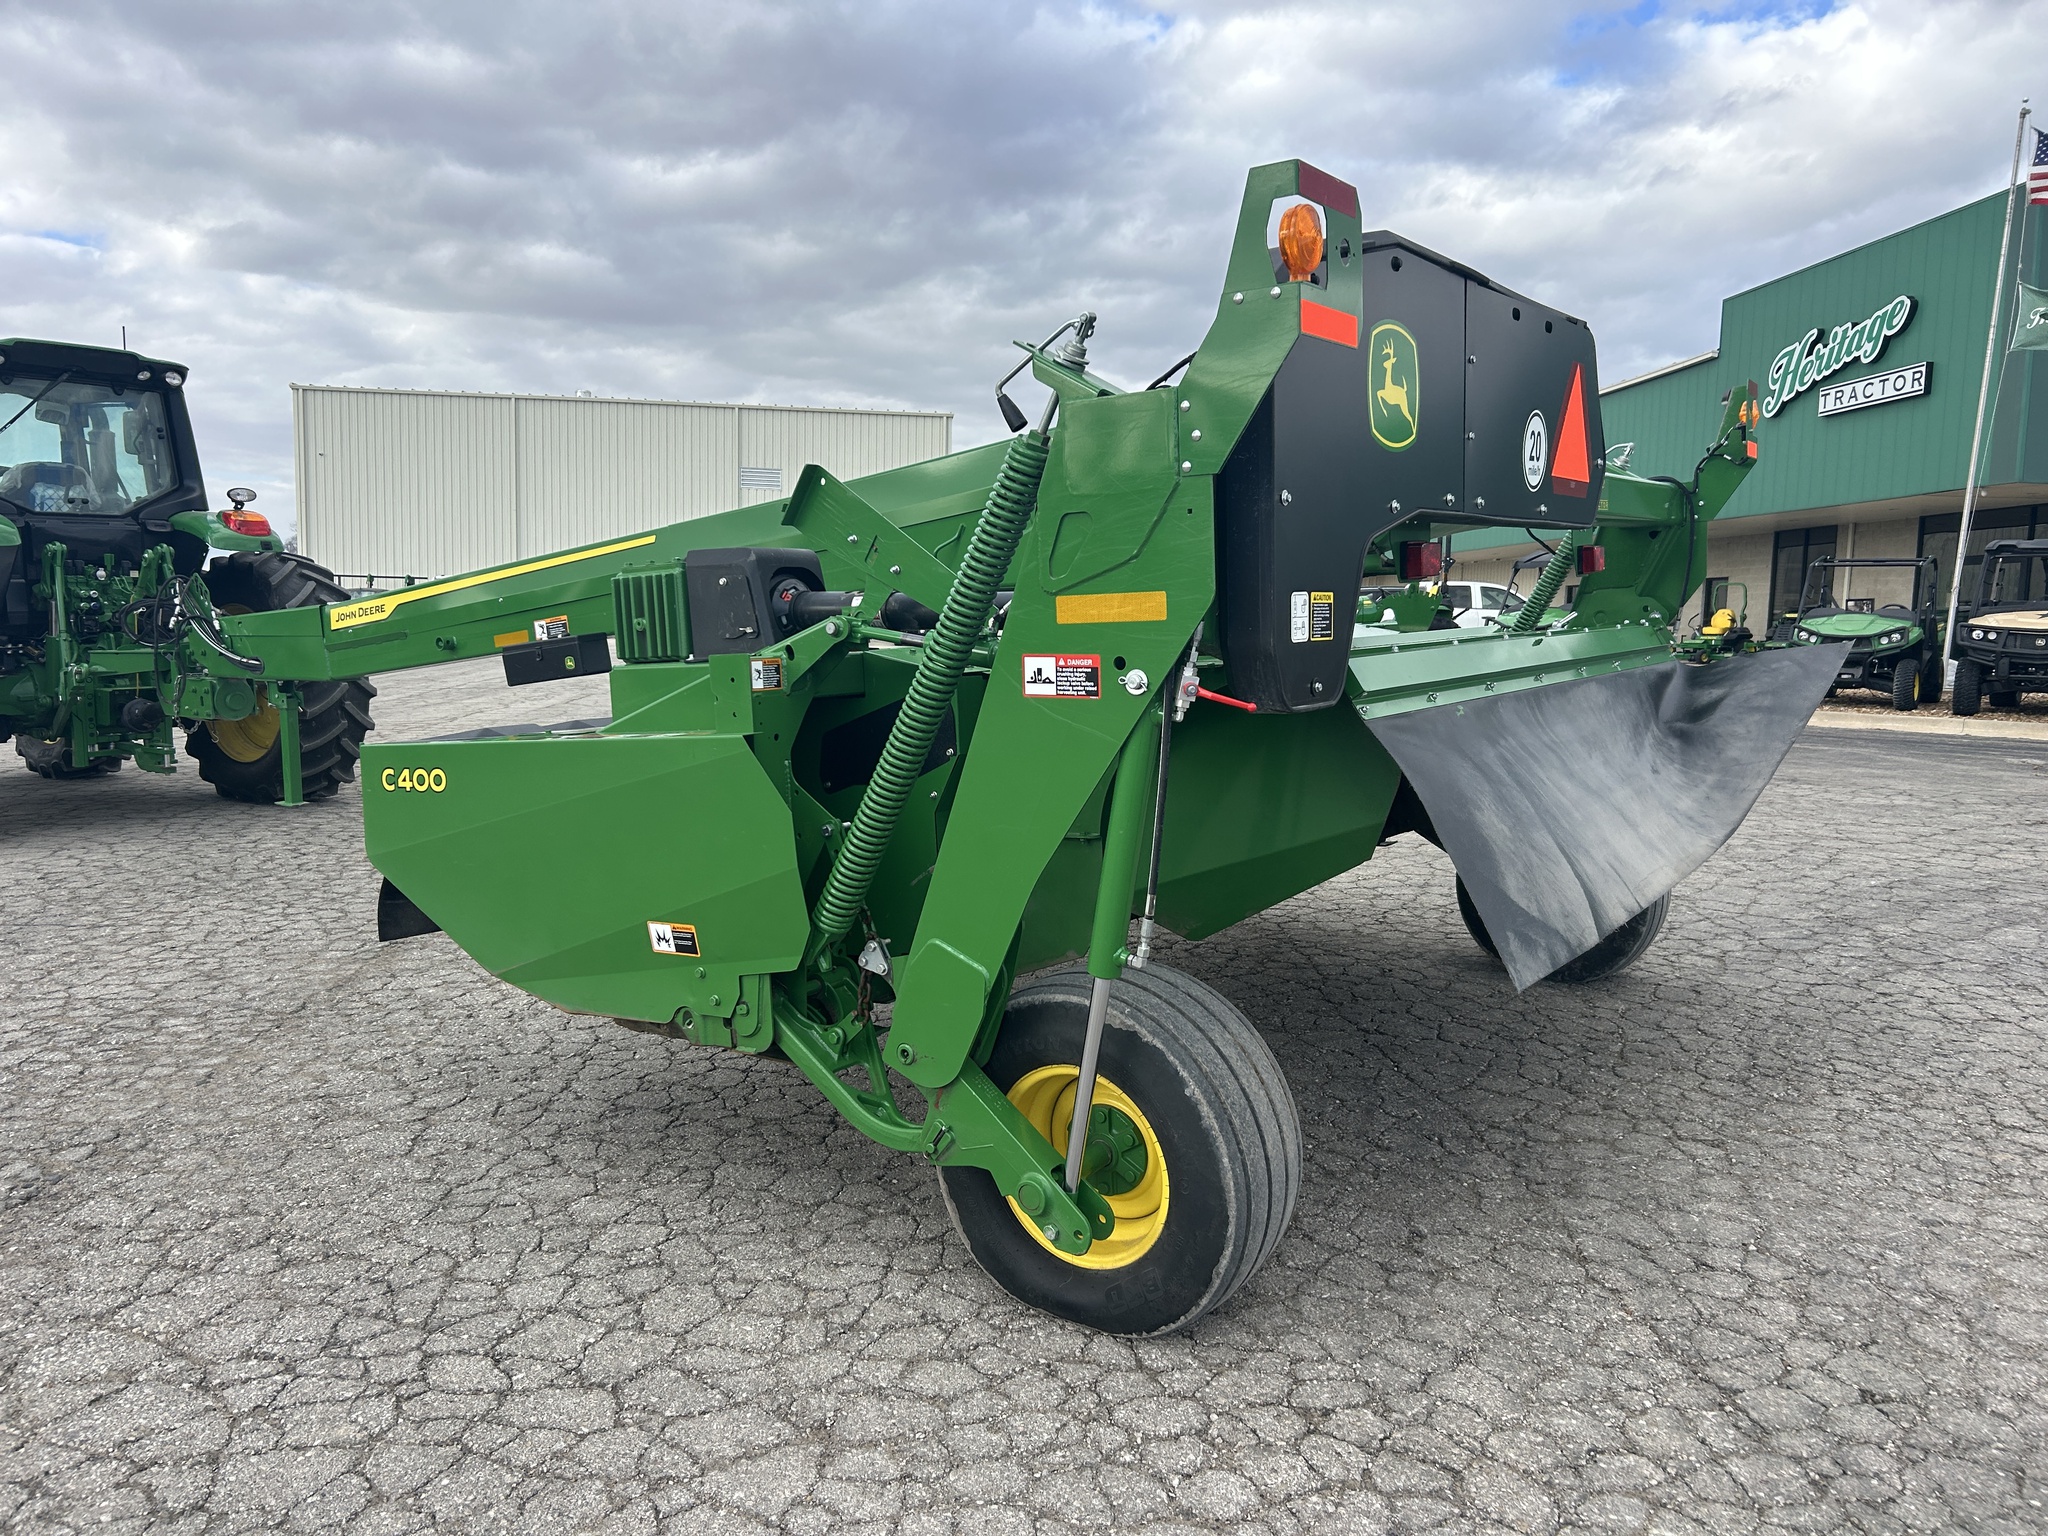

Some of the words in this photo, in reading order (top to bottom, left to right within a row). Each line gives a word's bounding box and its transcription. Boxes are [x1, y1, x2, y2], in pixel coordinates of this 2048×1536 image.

[1762, 294, 1912, 419] Heritage
[1820, 369, 1924, 410] TRACTOR
[1528, 429, 1542, 462] 20
[381, 767, 447, 793] C400
